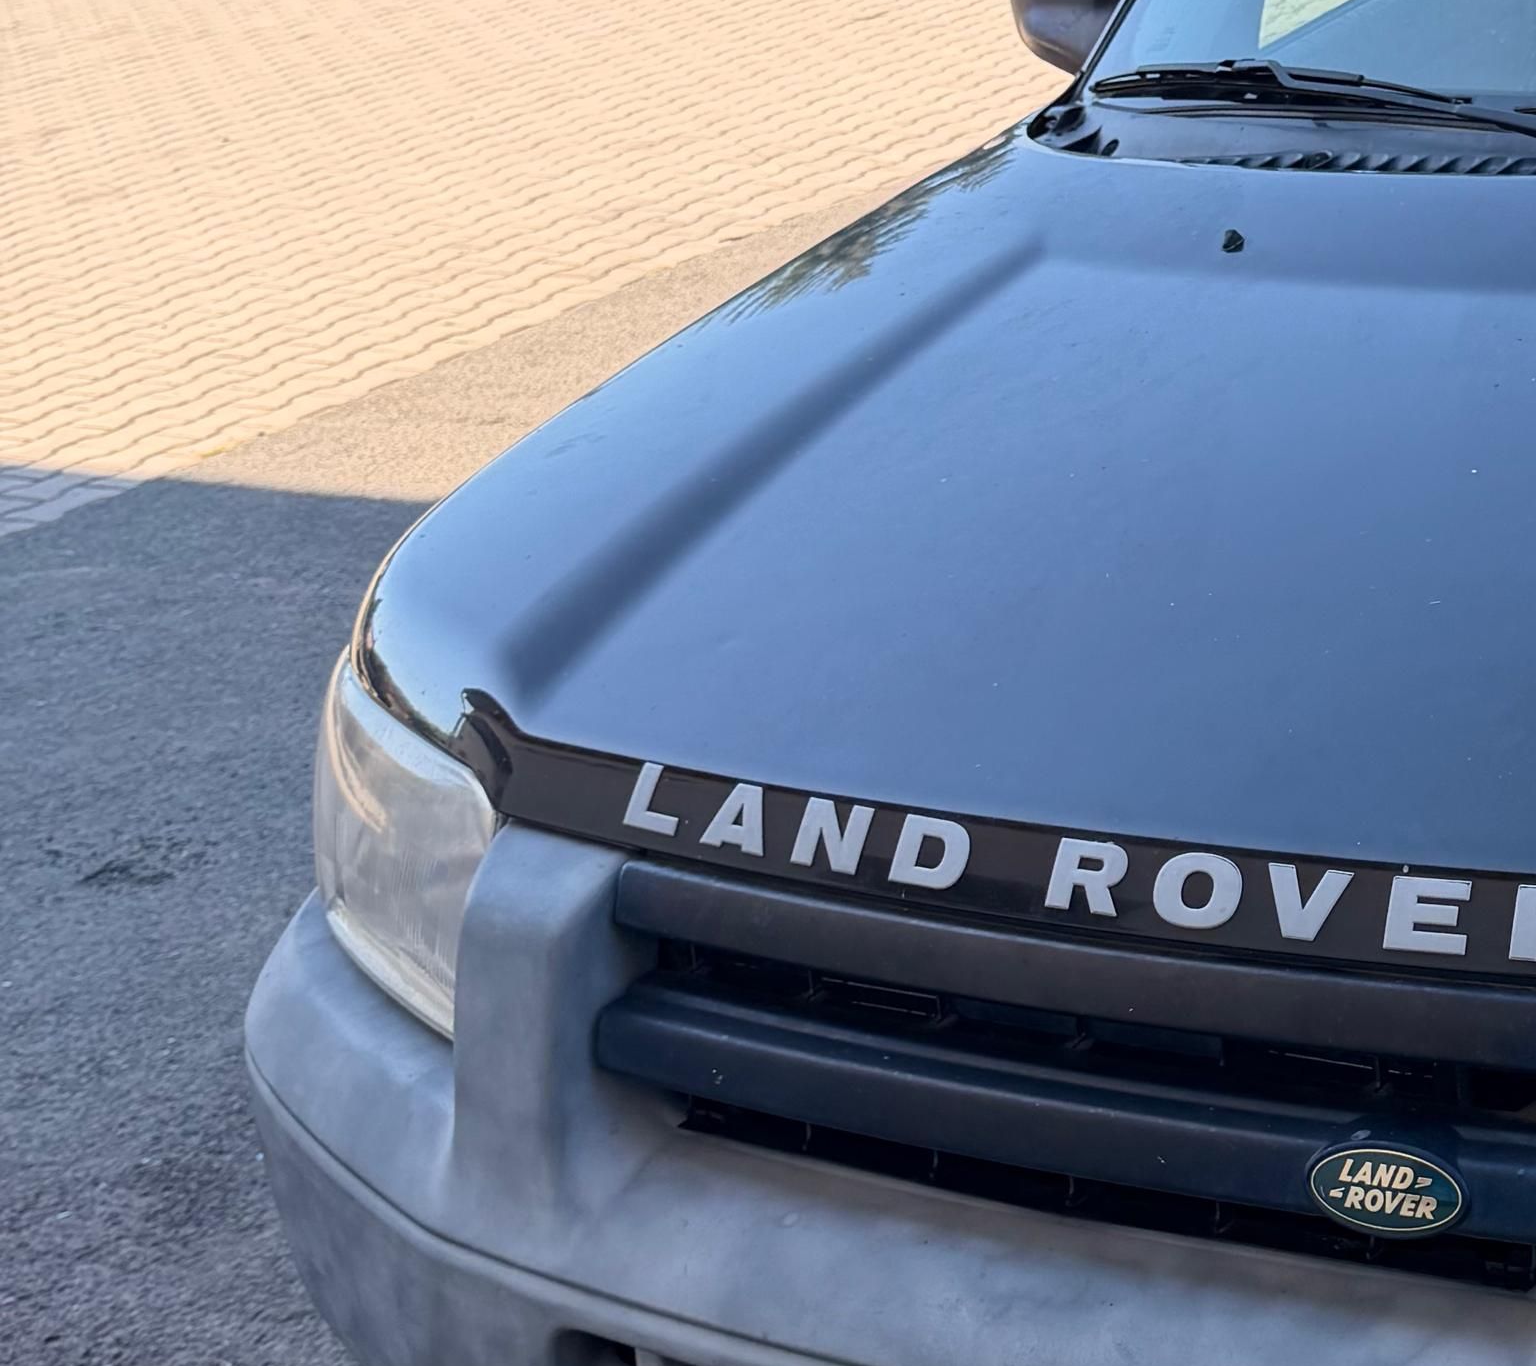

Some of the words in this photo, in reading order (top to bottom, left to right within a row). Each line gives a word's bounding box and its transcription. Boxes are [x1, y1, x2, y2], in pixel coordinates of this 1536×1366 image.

[621, 761, 972, 891] LAND
[1338, 1158, 1414, 1190] LAND
[1344, 1186, 1438, 1220] ROVER
